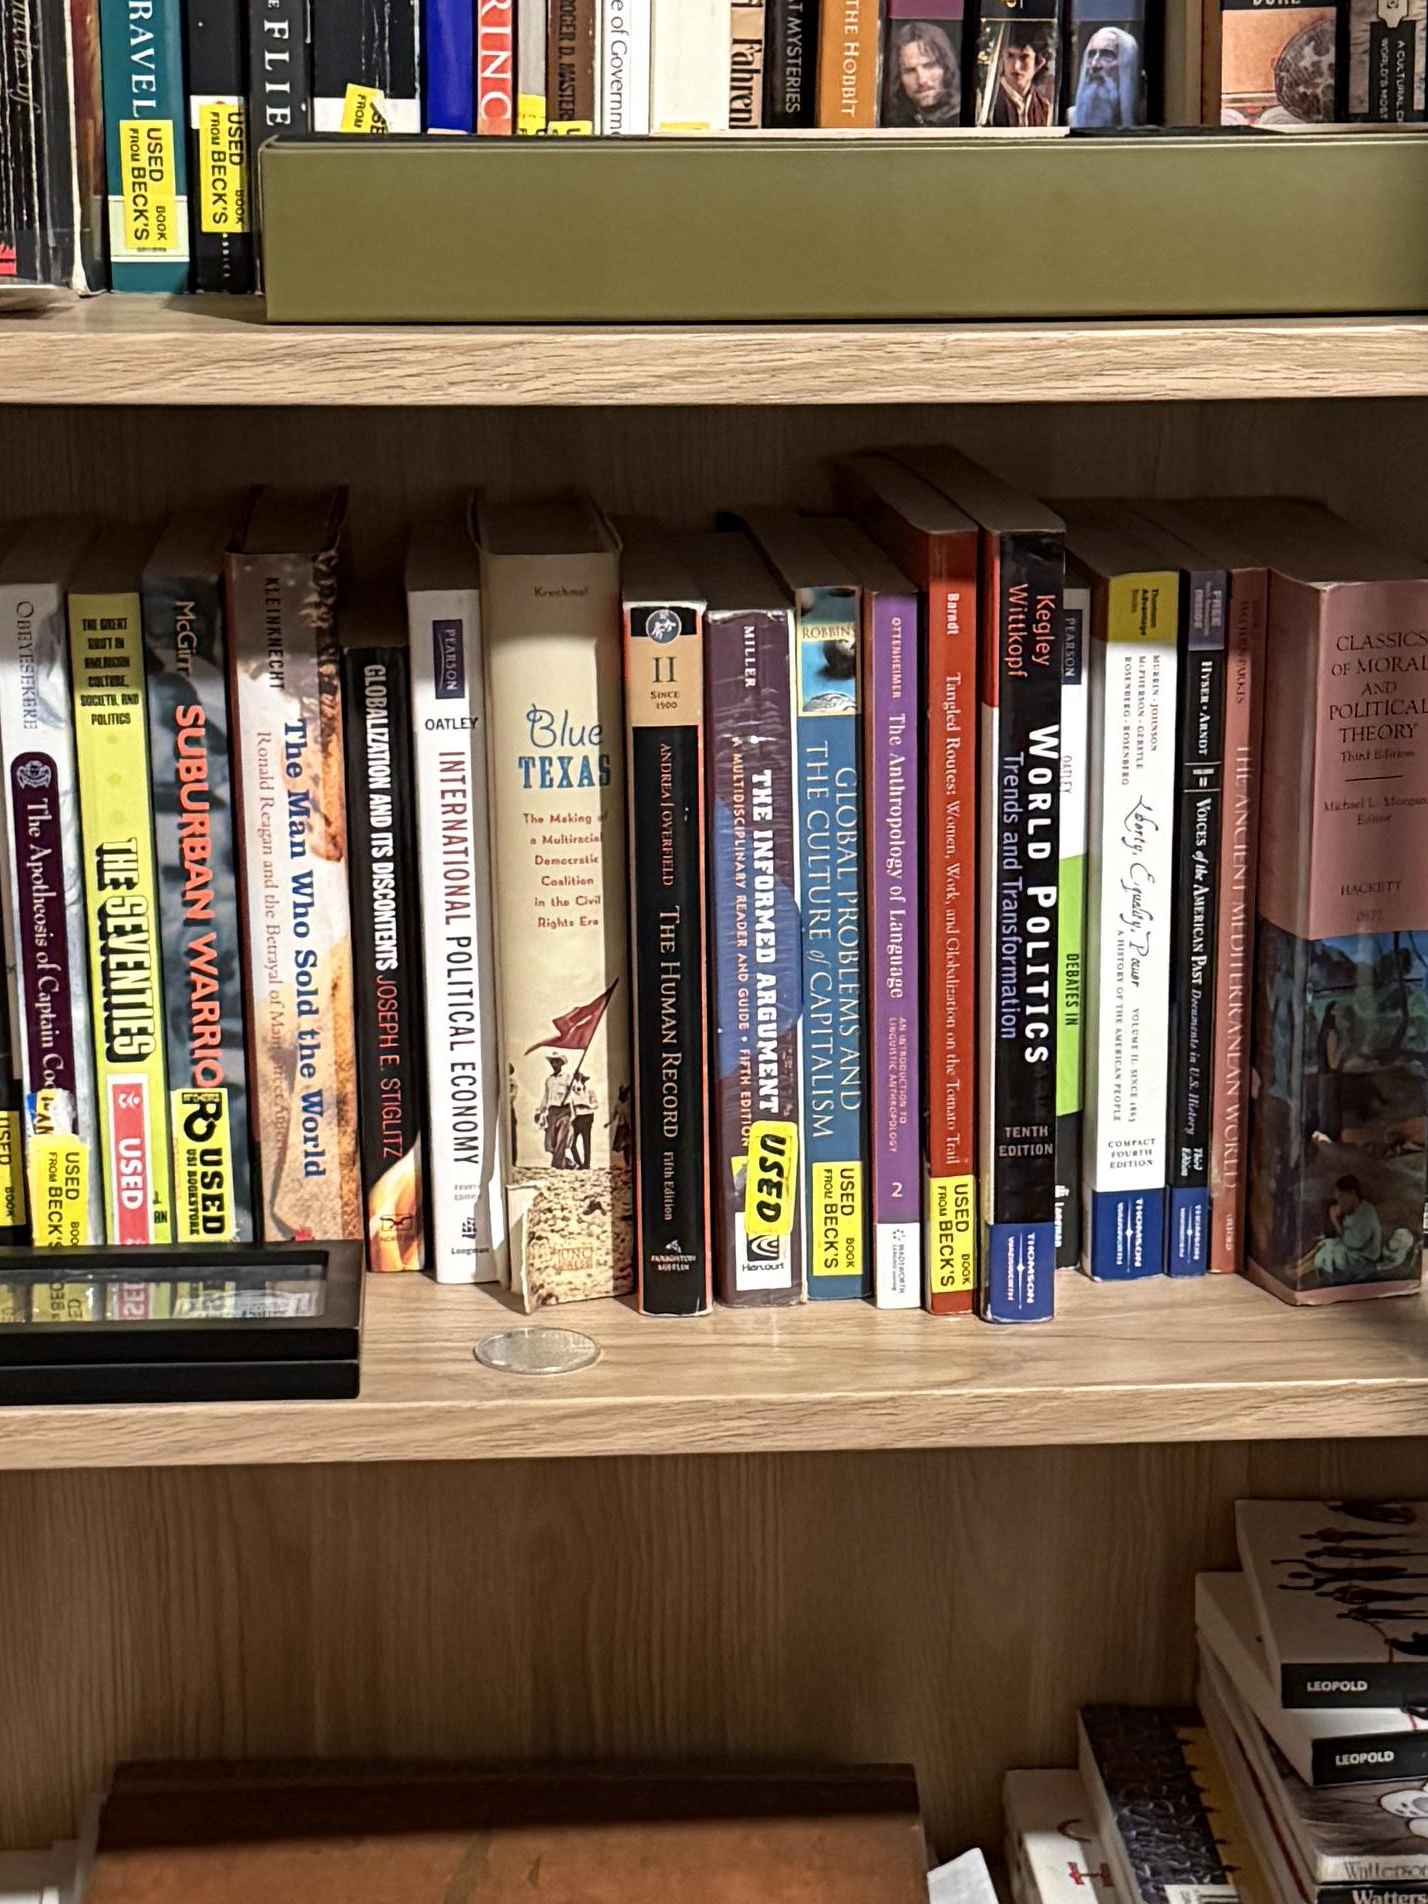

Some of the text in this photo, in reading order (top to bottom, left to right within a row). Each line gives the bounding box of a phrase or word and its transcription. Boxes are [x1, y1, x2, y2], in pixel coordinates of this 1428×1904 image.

[840, 43, 858, 119] HOBBIT
[1335, 630, 1428, 652] CLASSICS
[424, 717, 480, 732] OATLEY
[525, 703, 604, 749] Blue
[1338, 720, 1420, 744] THEORY
[518, 756, 611, 790] TEXAS
[174, 702, 216, 921] SUBURBAN
[1023, 722, 1062, 1067] WORLD POLITICS
[99, 895, 156, 1064] SEVENTIES
[282, 717, 328, 1180] The Man Who Sold the World
[755, 1131, 786, 1226] USED
